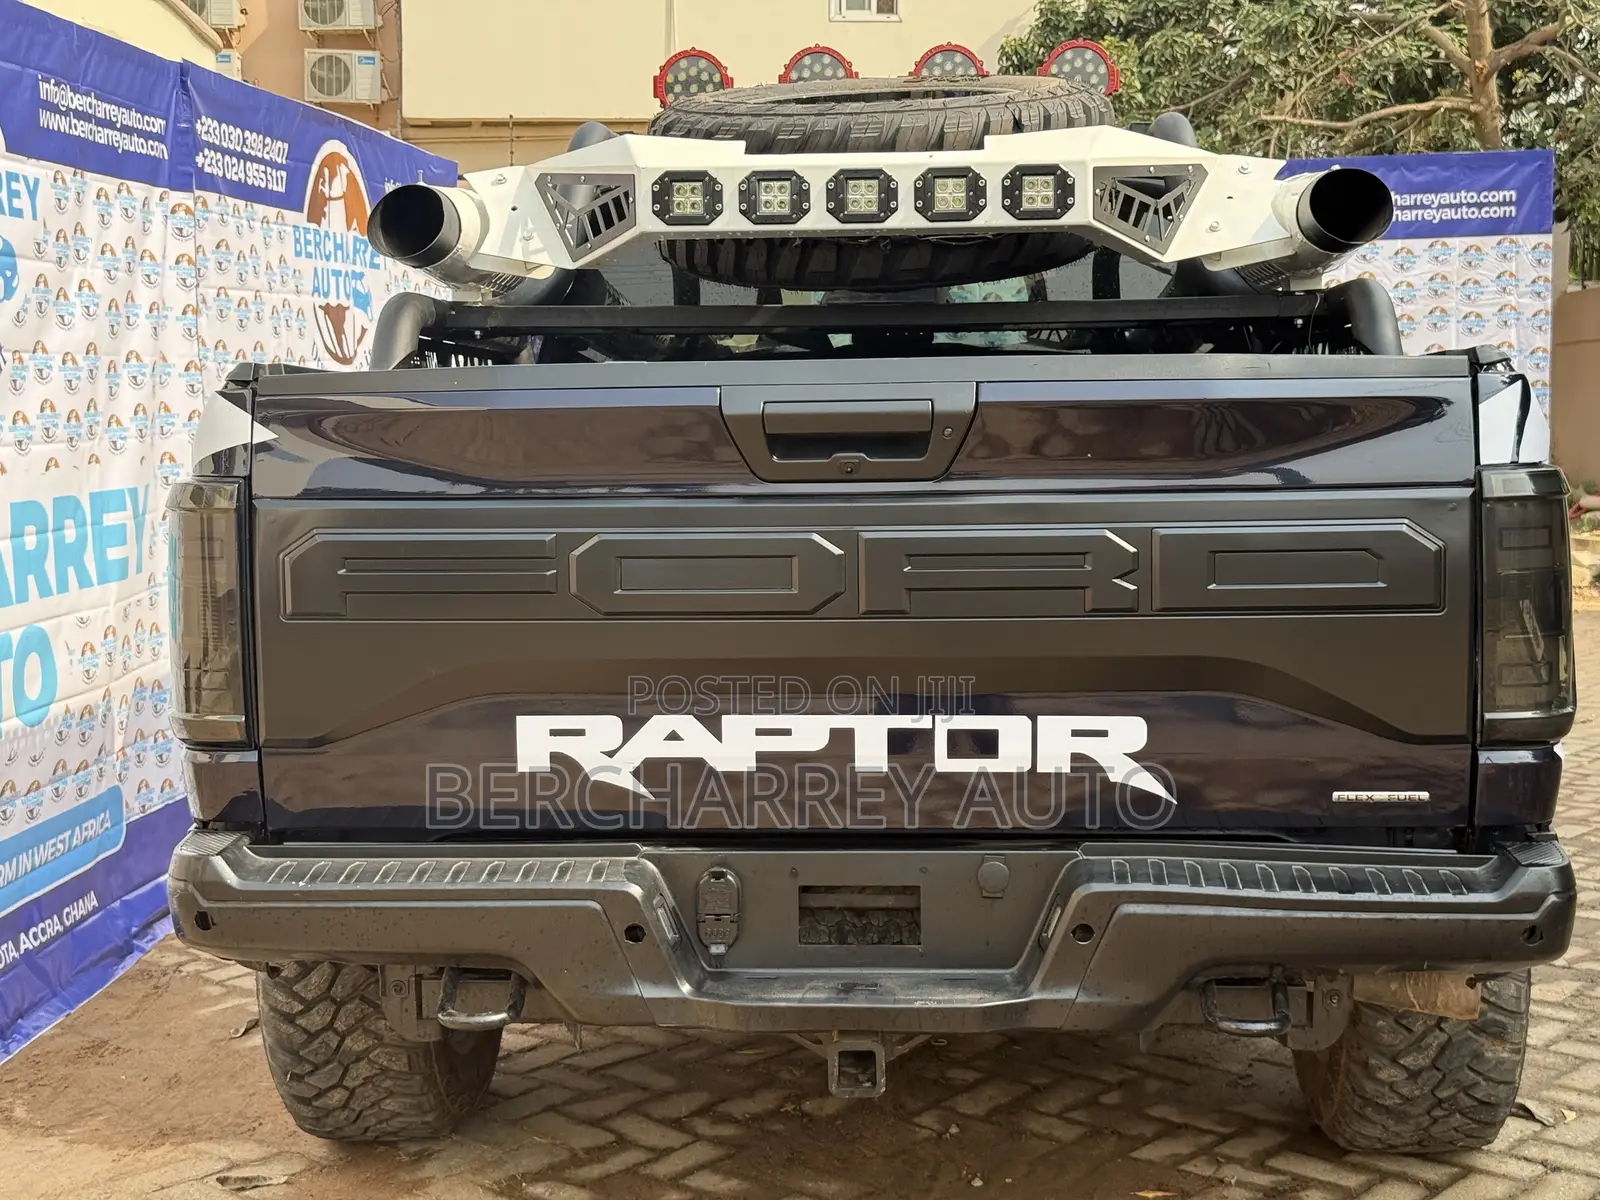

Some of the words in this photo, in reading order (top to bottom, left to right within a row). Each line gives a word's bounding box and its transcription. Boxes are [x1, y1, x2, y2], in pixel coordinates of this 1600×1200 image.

[38, 74, 166, 135] info@bercharreyauto.com
[195, 115, 220, 145] +233
[221, 122, 243, 152] 030
[242, 130, 264, 158] 398
[264, 136, 289, 164] 2407
[0, 170, 40, 222] EY
[195, 148, 223, 177] +233
[224, 154, 246, 184] 024
[245, 160, 266, 188] 955
[266, 166, 287, 193] 5117
[292, 224, 387, 270] BERCHARRE
[311, 266, 351, 301] AUTO
[282, 524, 1442, 617] FORD
[516, 714, 1178, 804] RAPTOR
[1337, 794, 1375, 802] FLEX
[18, 851, 32, 878] IN
[34, 830, 71, 867] WEST
[72, 809, 111, 850] AFRICA
[19, 914, 64, 956] ACCRA,
[63, 890, 99, 927] GHANA
